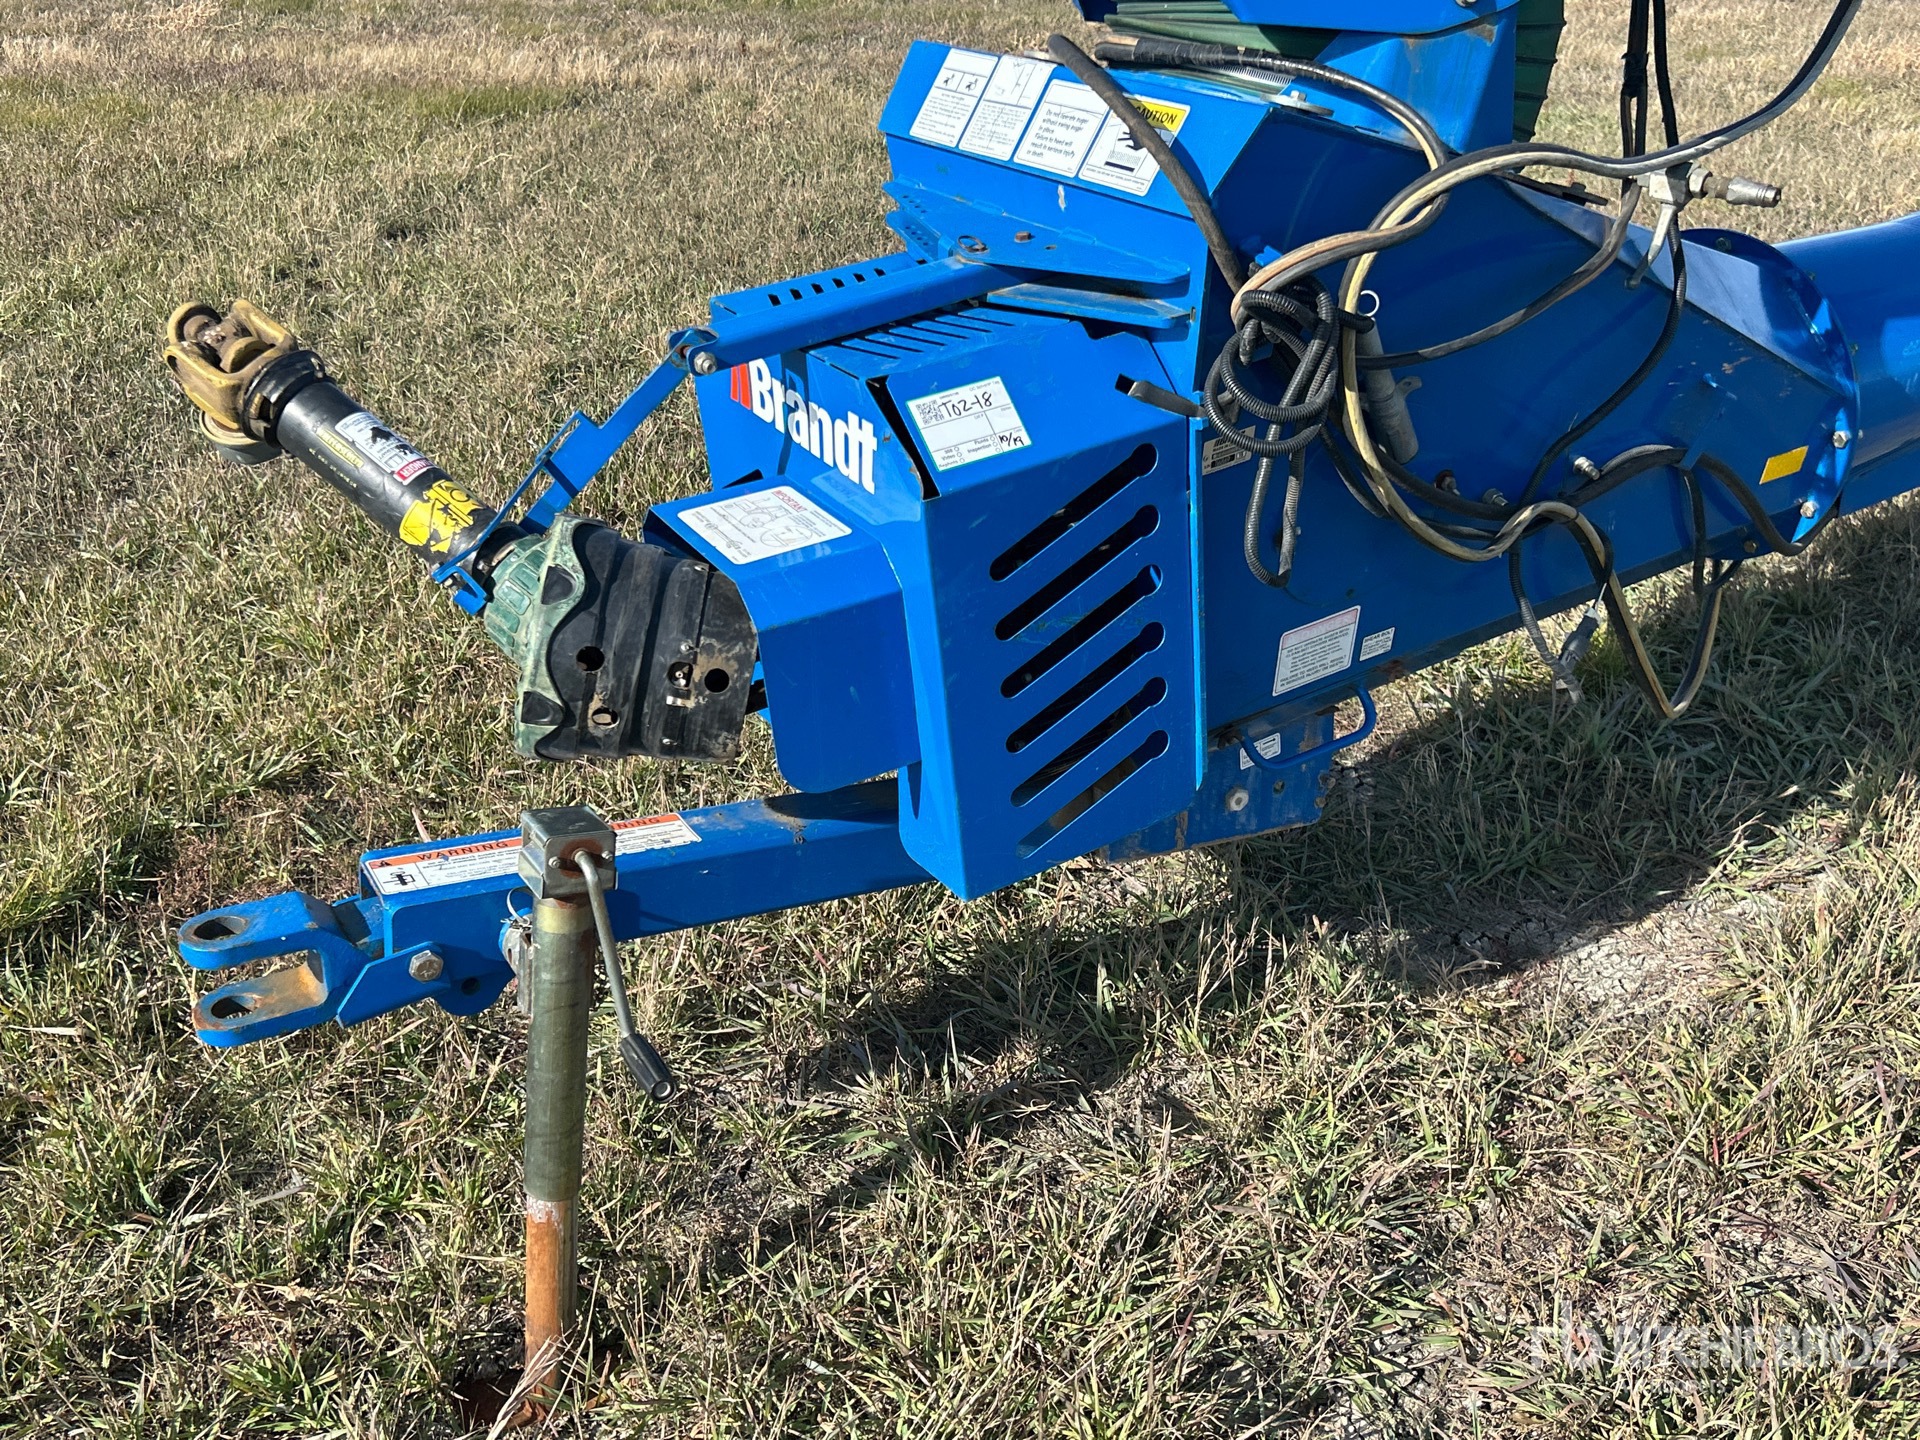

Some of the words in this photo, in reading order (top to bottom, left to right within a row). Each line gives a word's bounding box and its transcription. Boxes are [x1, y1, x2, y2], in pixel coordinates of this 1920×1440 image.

[748, 358, 877, 495] Brandt
[610, 817, 660, 830] NING
[417, 842, 508, 860] WARNING
